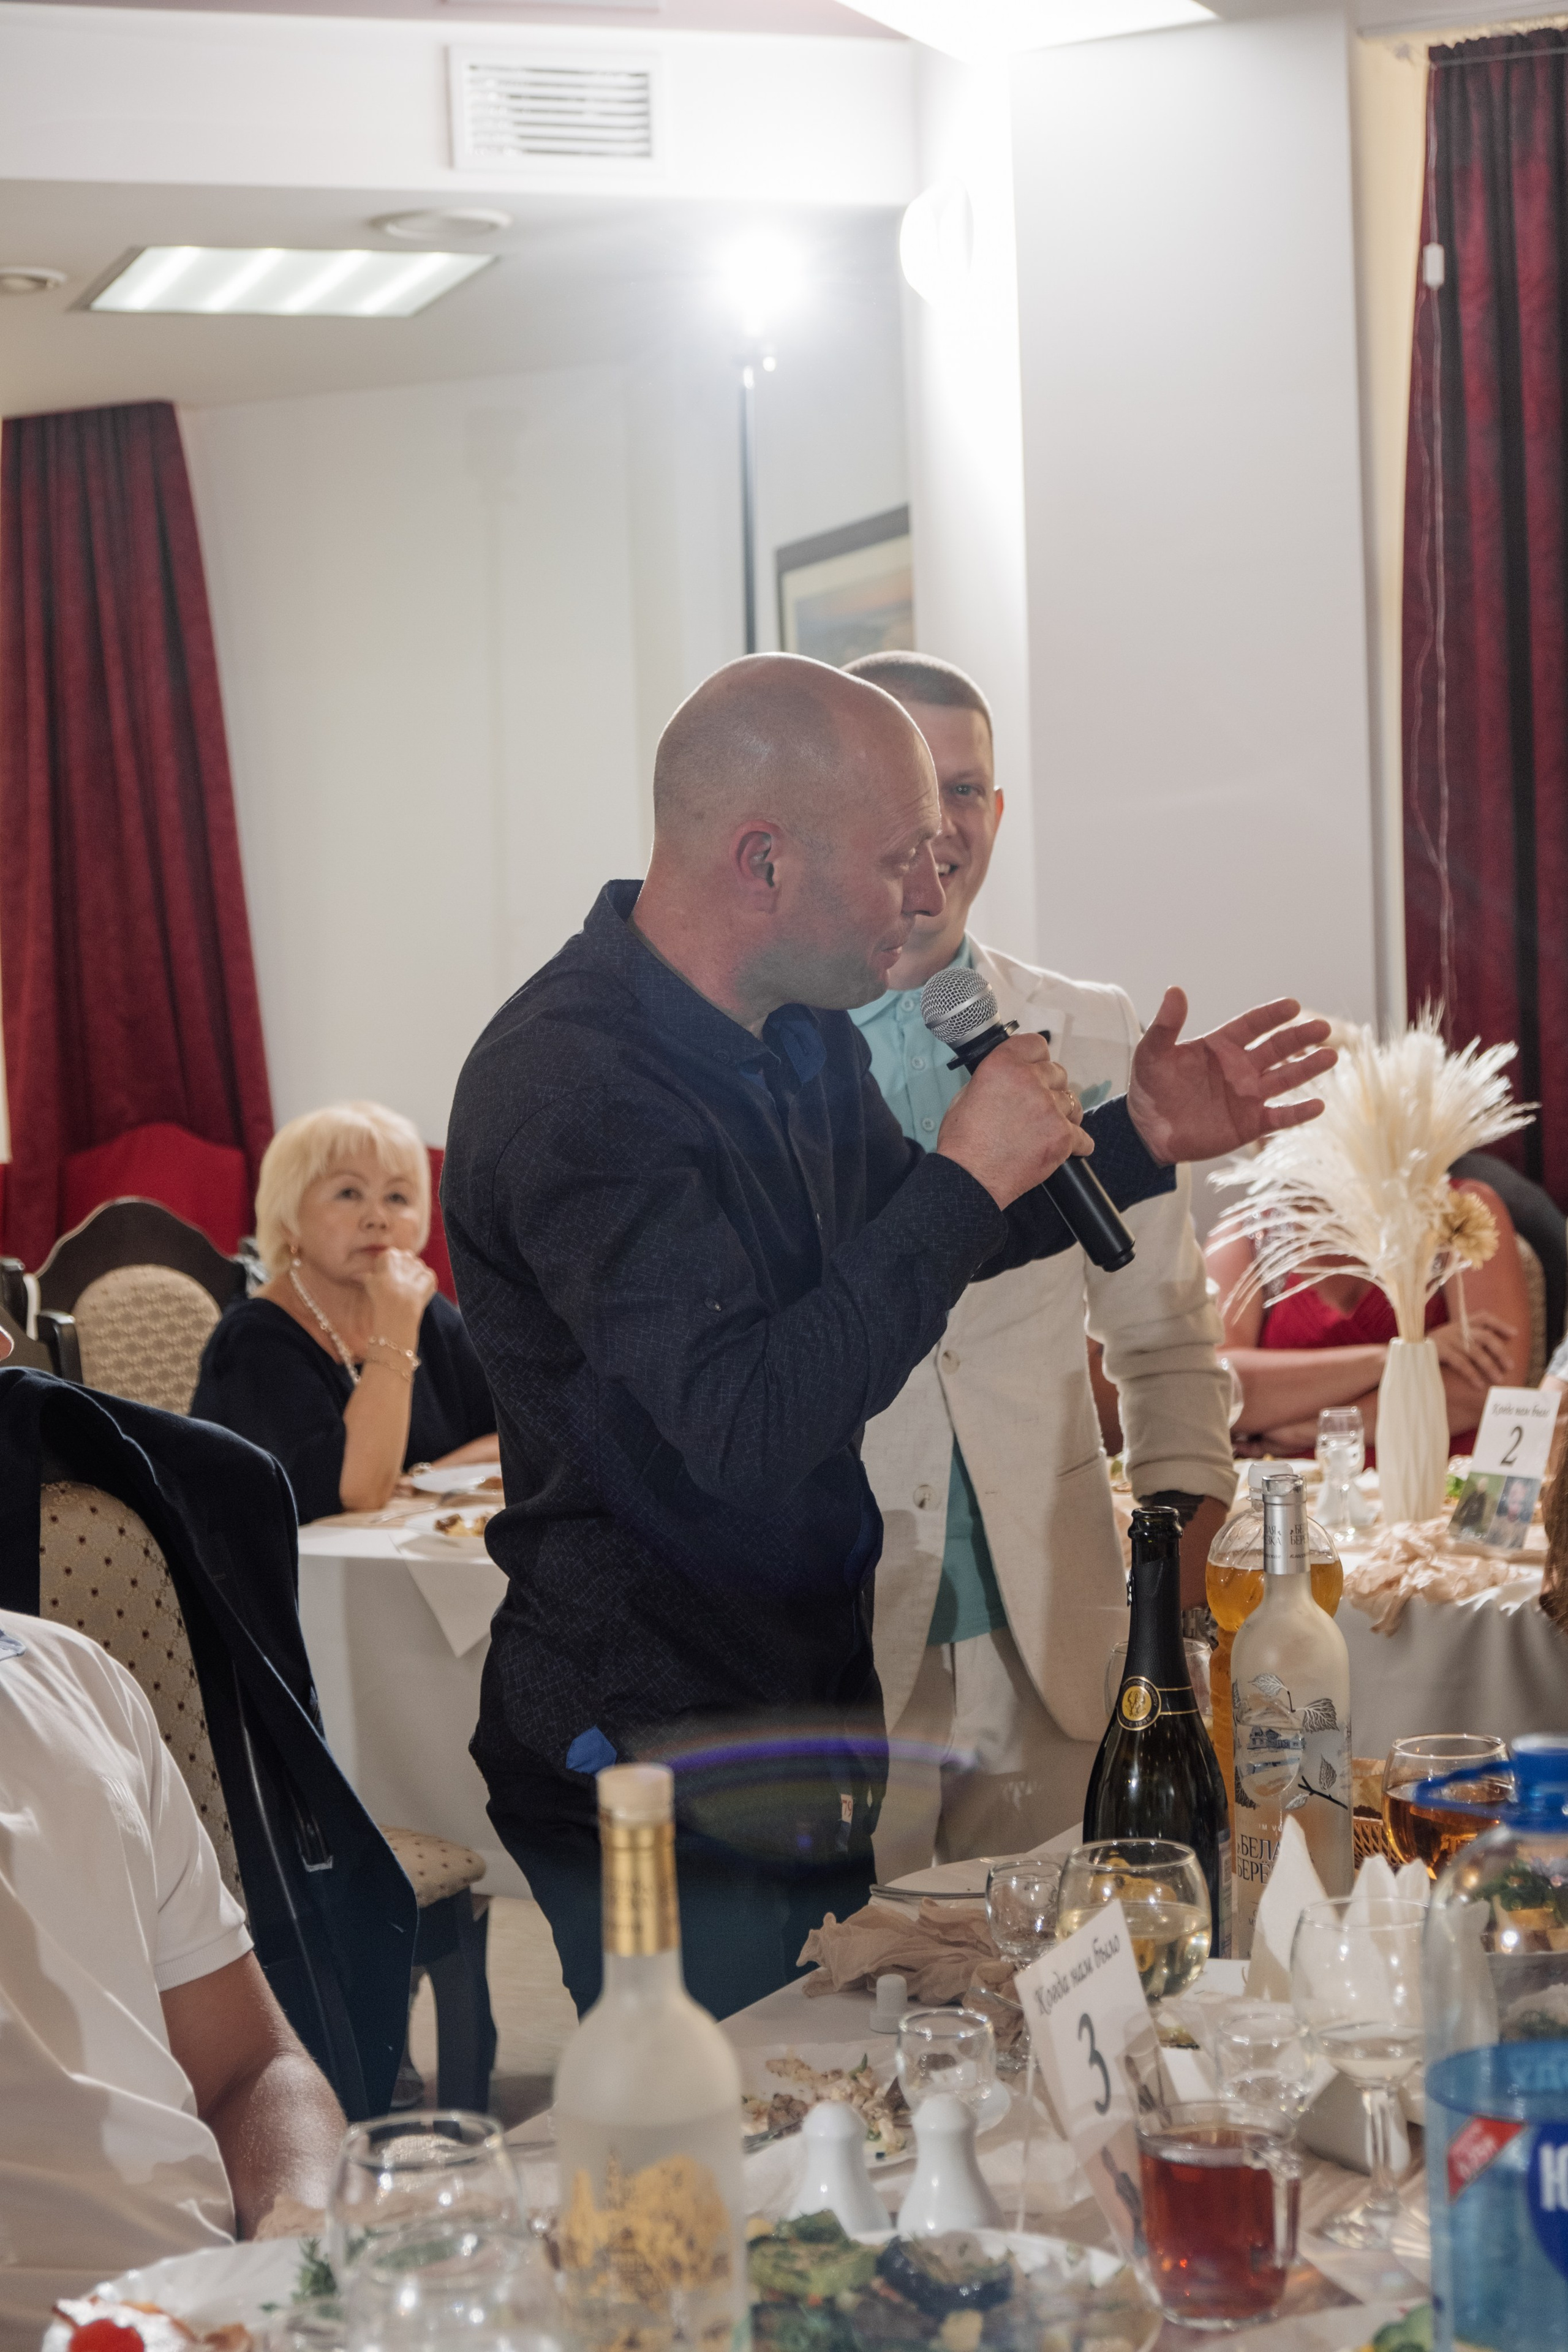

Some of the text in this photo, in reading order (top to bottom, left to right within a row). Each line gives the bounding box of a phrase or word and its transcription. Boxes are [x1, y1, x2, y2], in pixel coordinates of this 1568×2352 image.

[1499, 1425, 1523, 1468] 2
[1093, 1935, 1120, 1969] было
[1078, 2013, 1111, 2116] 3
